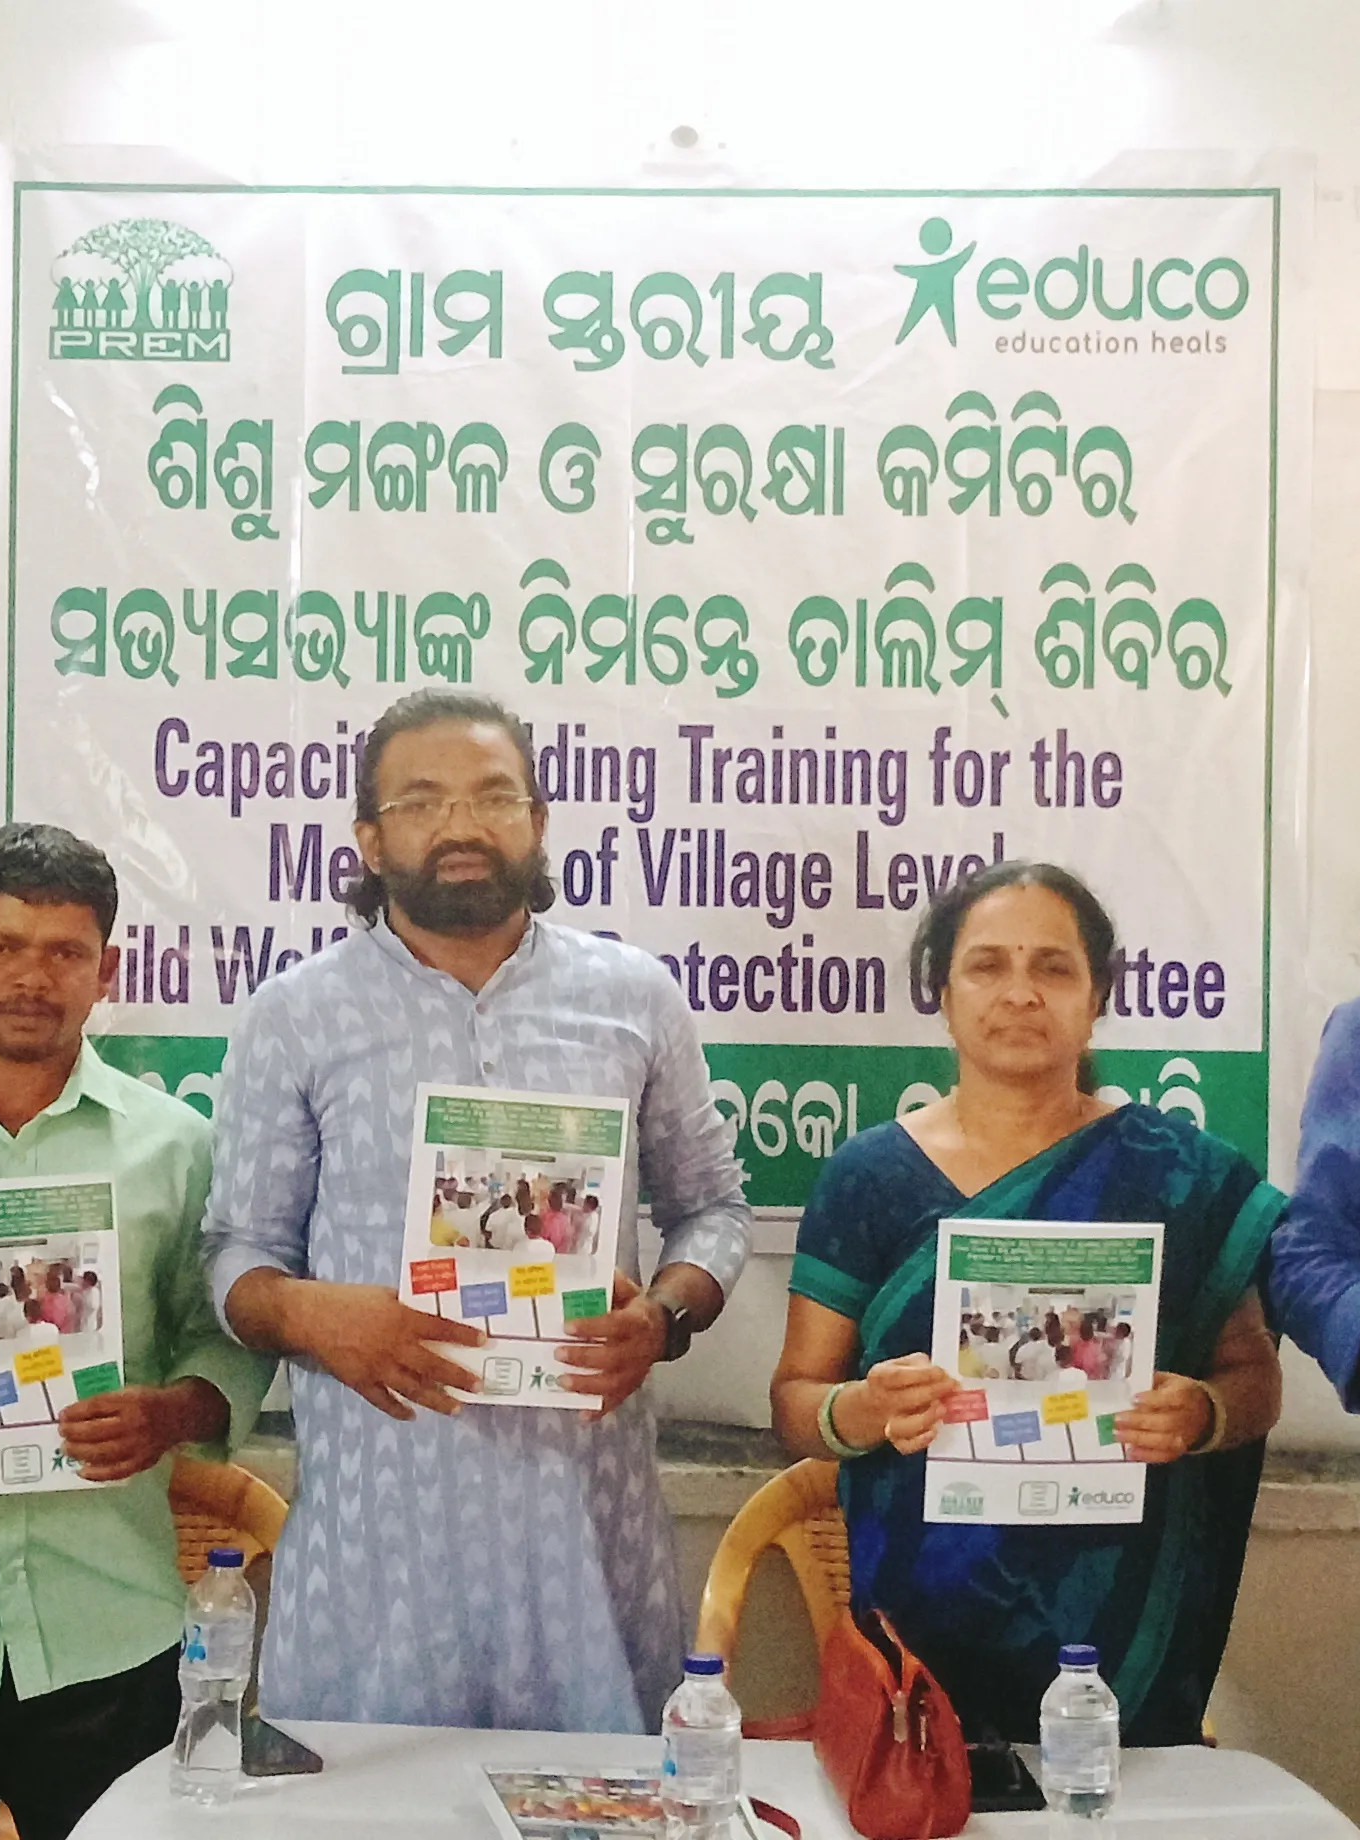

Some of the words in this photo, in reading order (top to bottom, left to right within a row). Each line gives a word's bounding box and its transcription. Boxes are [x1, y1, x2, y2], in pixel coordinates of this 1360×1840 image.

[326, 269, 503, 374] ଗ୍ରାମ
[543, 270, 835, 372] ସ୍ତରୀୟ
[976, 244, 1249, 321] educo
[53, 330, 229, 359] PREM
[995, 329, 1138, 354] education
[1151, 330, 1227, 354] heals
[148, 384, 280, 541] ଶିଶୁ
[305, 420, 509, 513] ମଙ୍ଗଳ
[539, 421, 602, 514] ଓ
[631, 422, 844, 546] ସୁରକ୍ଷା
[877, 390, 1137, 525] କମିଟିର
[519, 558, 759, 699] ନିମନ୍ତେ
[789, 562, 1009, 718] ତାଲିମ୍
[1035, 562, 1232, 698] ଶିବିର
[155, 717, 368, 818] Capacit
[678, 725, 908, 826] Training
[928, 726, 1011, 808] for
[1030, 728, 1123, 809] the
[563, 826, 618, 906] of
[636, 827, 833, 929] Village
[107, 925, 190, 1004] ild
[658, 934, 886, 1014] tection
[909, 947, 1225, 1019] Cttee
